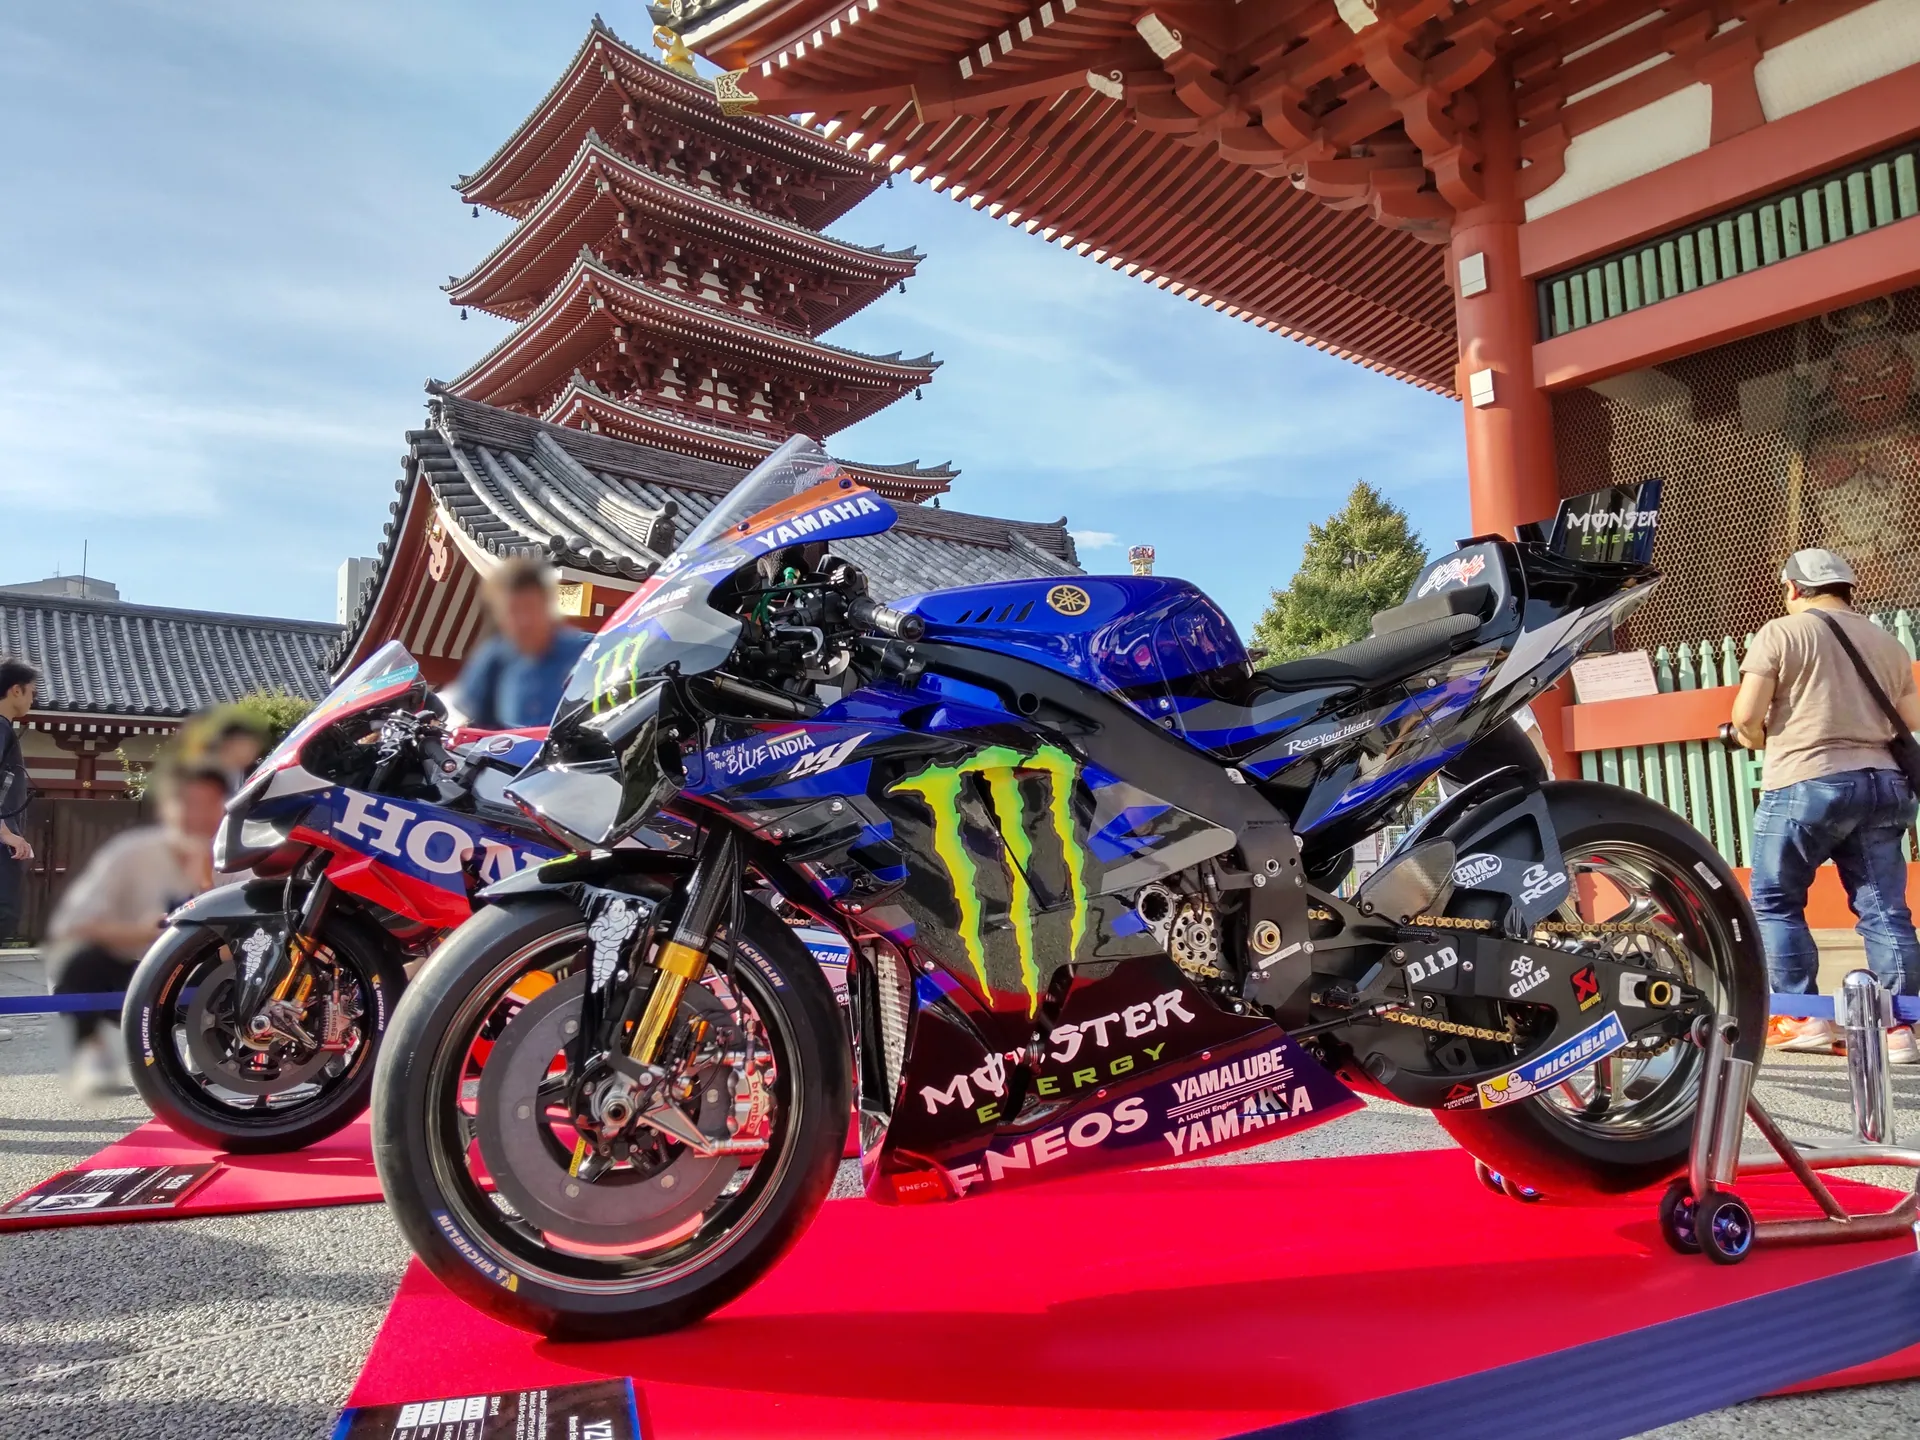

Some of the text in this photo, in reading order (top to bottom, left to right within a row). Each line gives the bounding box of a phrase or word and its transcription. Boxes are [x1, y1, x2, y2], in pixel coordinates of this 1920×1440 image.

[756, 497, 880, 549] YAMAHA
[727, 745, 768, 776] BLUE
[769, 735, 816, 760] INDIA
[1284, 719, 1372, 755] Revs Your Heart
[333, 789, 547, 885] HON
[1456, 856, 1497, 881] BMC
[1520, 872, 1567, 905] RCB
[736, 940, 784, 988] ICHELIN
[1407, 948, 1458, 983] D.I.D
[1508, 965, 1550, 998] GILLES
[376, 990, 385, 1031] MICHELIN
[1534, 1022, 1618, 1080] MICHELIN
[976, 1042, 1166, 1124] EERGY
[1172, 1046, 1285, 1103] YAMALUBE
[751, 1081, 760, 1128] brembo
[1186, 1109, 1211, 1121] Liquid
[569, 1138, 585, 1176] TRANSPOR
[949, 1097, 1147, 1198] ENEOS
[437, 1215, 496, 1274] MICHELIN
[584, 1419, 613, 1440] YZ
